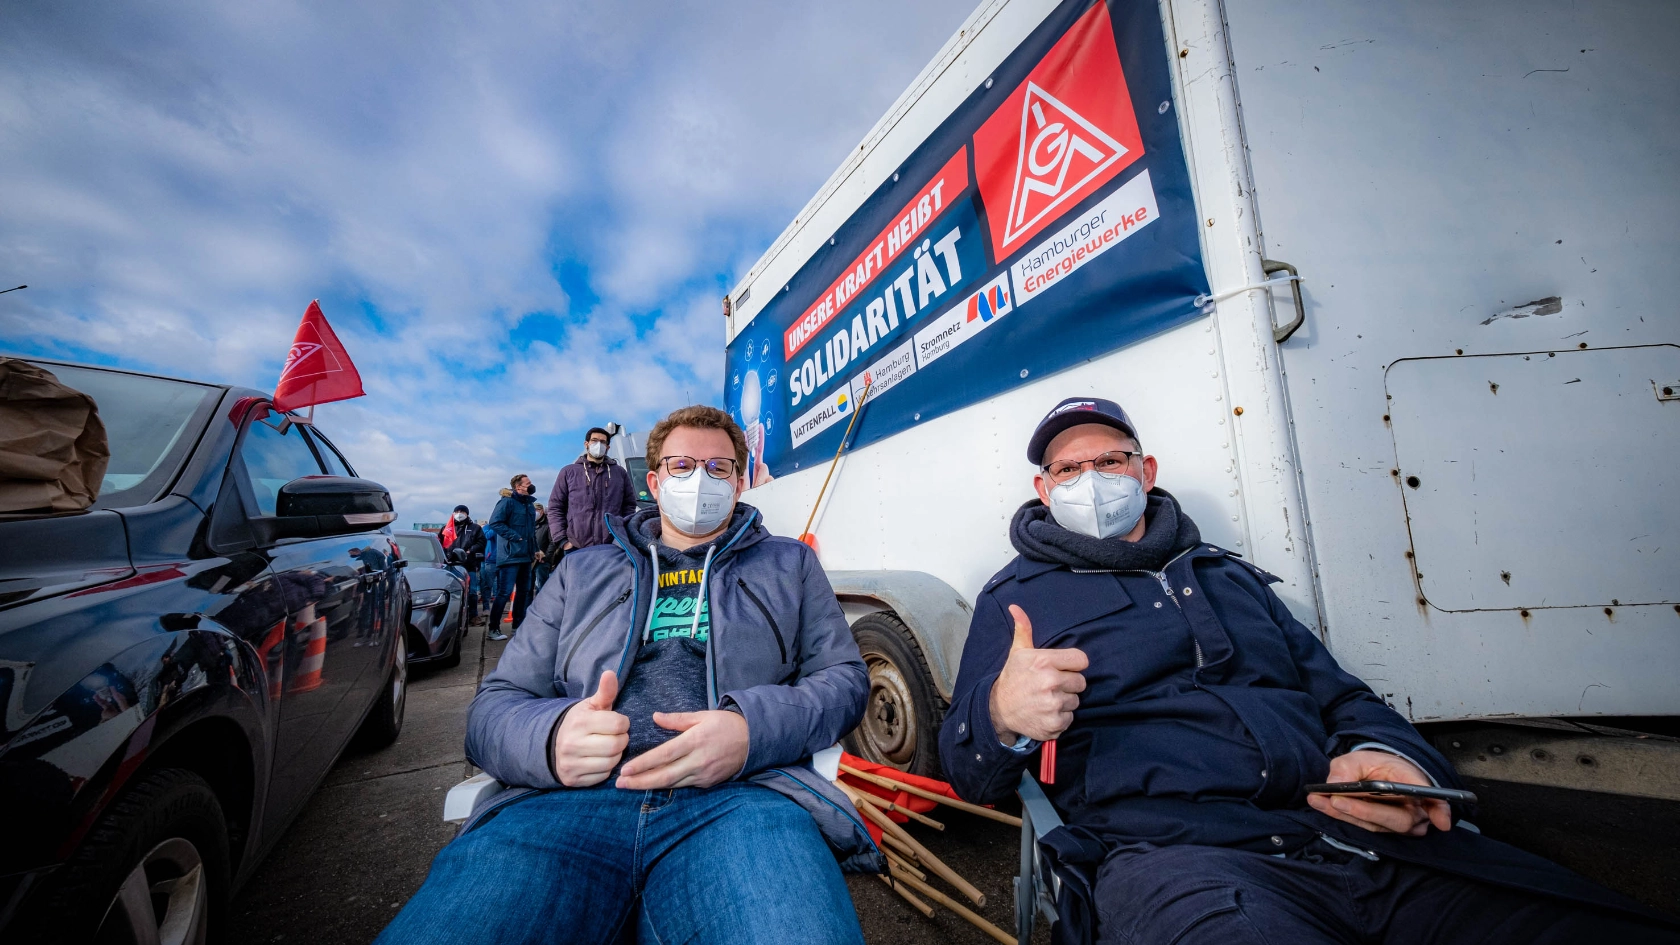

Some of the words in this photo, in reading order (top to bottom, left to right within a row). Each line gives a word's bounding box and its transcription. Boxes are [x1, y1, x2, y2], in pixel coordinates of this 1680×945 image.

[1021, 209, 1107, 277] Hamburger
[1024, 207, 1147, 293] Energiewerke
[788, 293, 834, 352] UNSERE
[835, 241, 884, 309] KRAFT
[789, 226, 962, 406] SOLIDARITÄT
[920, 321, 961, 353] Stromnetz
[922, 340, 950, 362] Hamburg
[875, 352, 910, 379] Hamburg
[793, 405, 837, 439] VATTENFALL
